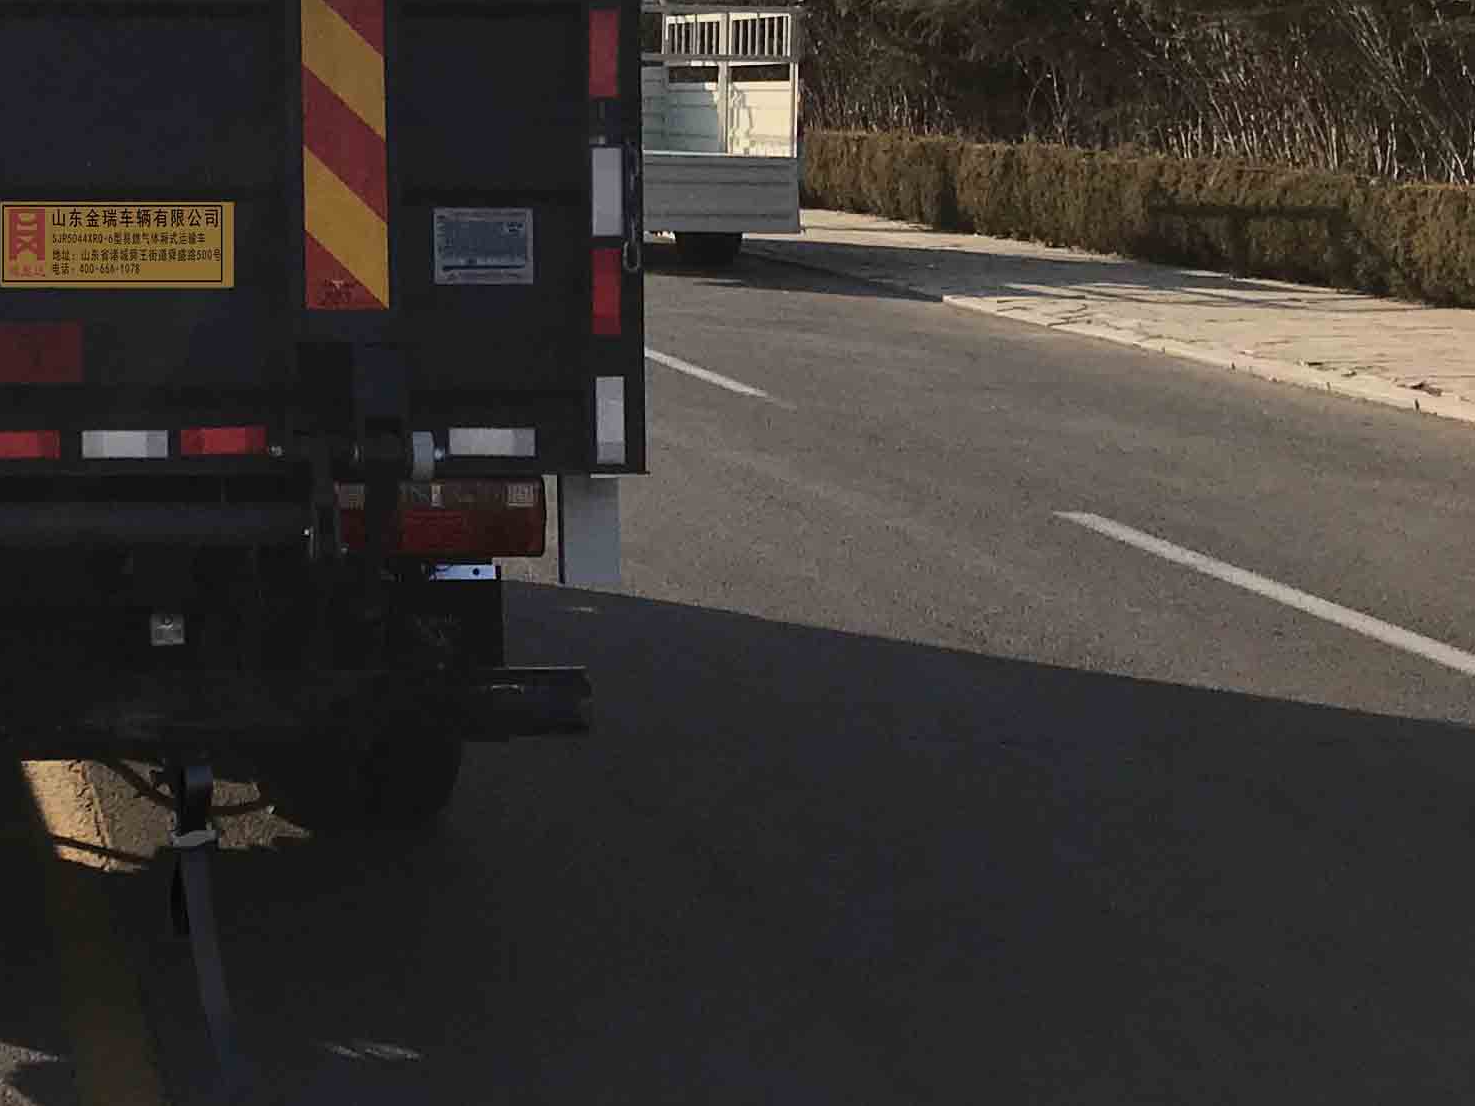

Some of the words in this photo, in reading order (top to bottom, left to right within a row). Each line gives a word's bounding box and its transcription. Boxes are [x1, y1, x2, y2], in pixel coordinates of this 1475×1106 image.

[52, 208, 220, 228] 山东金瑞车辆有限公司
